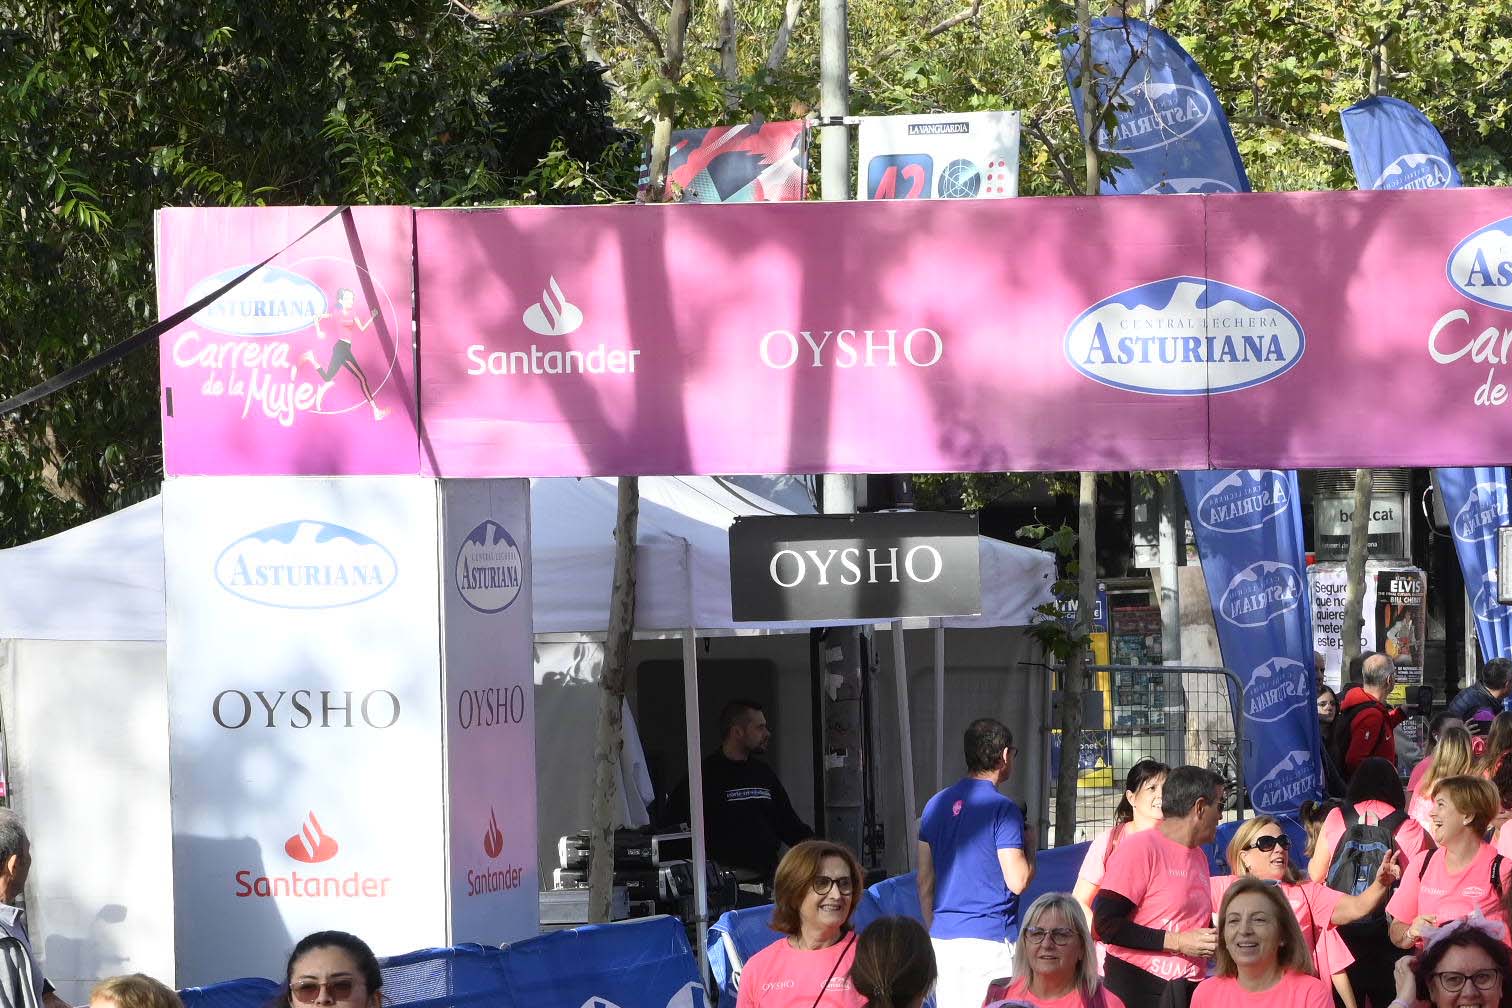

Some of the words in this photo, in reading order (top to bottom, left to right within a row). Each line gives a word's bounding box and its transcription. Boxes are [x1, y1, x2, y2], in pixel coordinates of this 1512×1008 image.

[173, 330, 291, 368] Carrera
[467, 344, 640, 376] Santander
[759, 328, 943, 369] OYSHO
[1083, 322, 1287, 364] ASTURIANA
[202, 371, 226, 395] de
[229, 371, 244, 395] la
[242, 366, 335, 426] Mujer
[1474, 367, 1508, 406] de
[230, 554, 384, 587] ASTURIANA
[461, 556, 518, 591] ASTURIANA
[769, 545, 943, 588] OYSHO
[1316, 597, 1335, 608] que
[1390, 580, 1421, 593] ELVIS
[1318, 637, 1336, 646] este
[212, 690, 400, 729] OYSHO
[458, 685, 525, 729] OYSHO
[235, 870, 392, 898] Santander
[468, 864, 523, 897] Santander
[1151, 958, 1199, 978] SUMA
[762, 980, 795, 991] OYSHO
